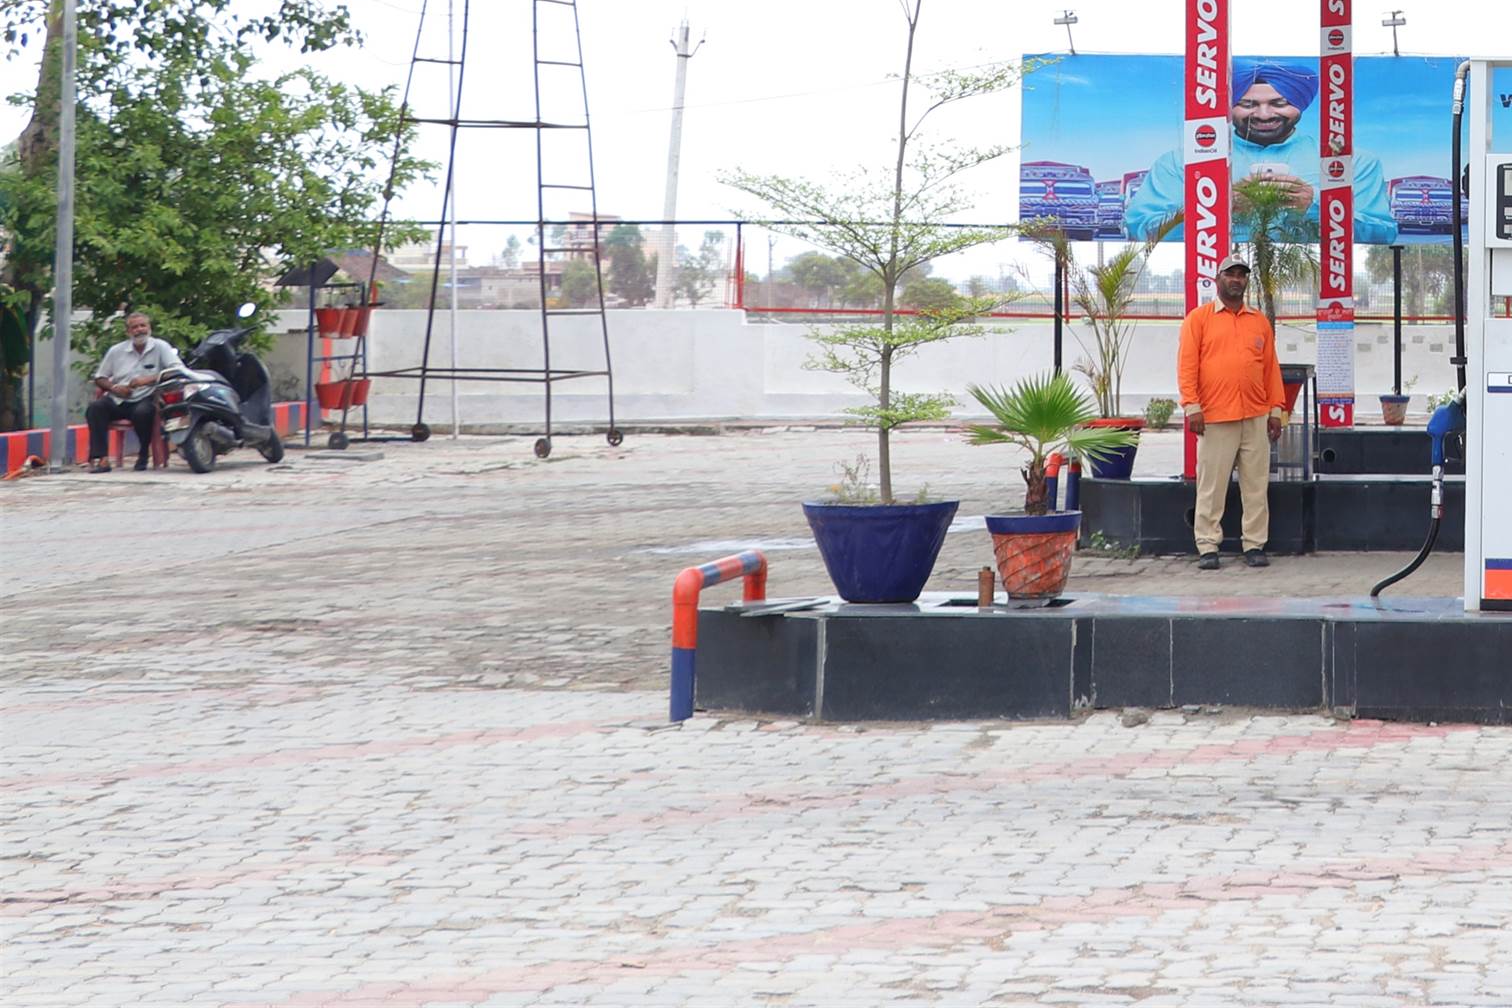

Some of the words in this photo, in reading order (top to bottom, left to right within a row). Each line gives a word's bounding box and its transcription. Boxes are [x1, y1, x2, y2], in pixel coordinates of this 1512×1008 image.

[1329, 63, 1345, 150] SERVO
[1196, 176, 1217, 282] ERVO
[1329, 198, 1346, 292] SERVO
